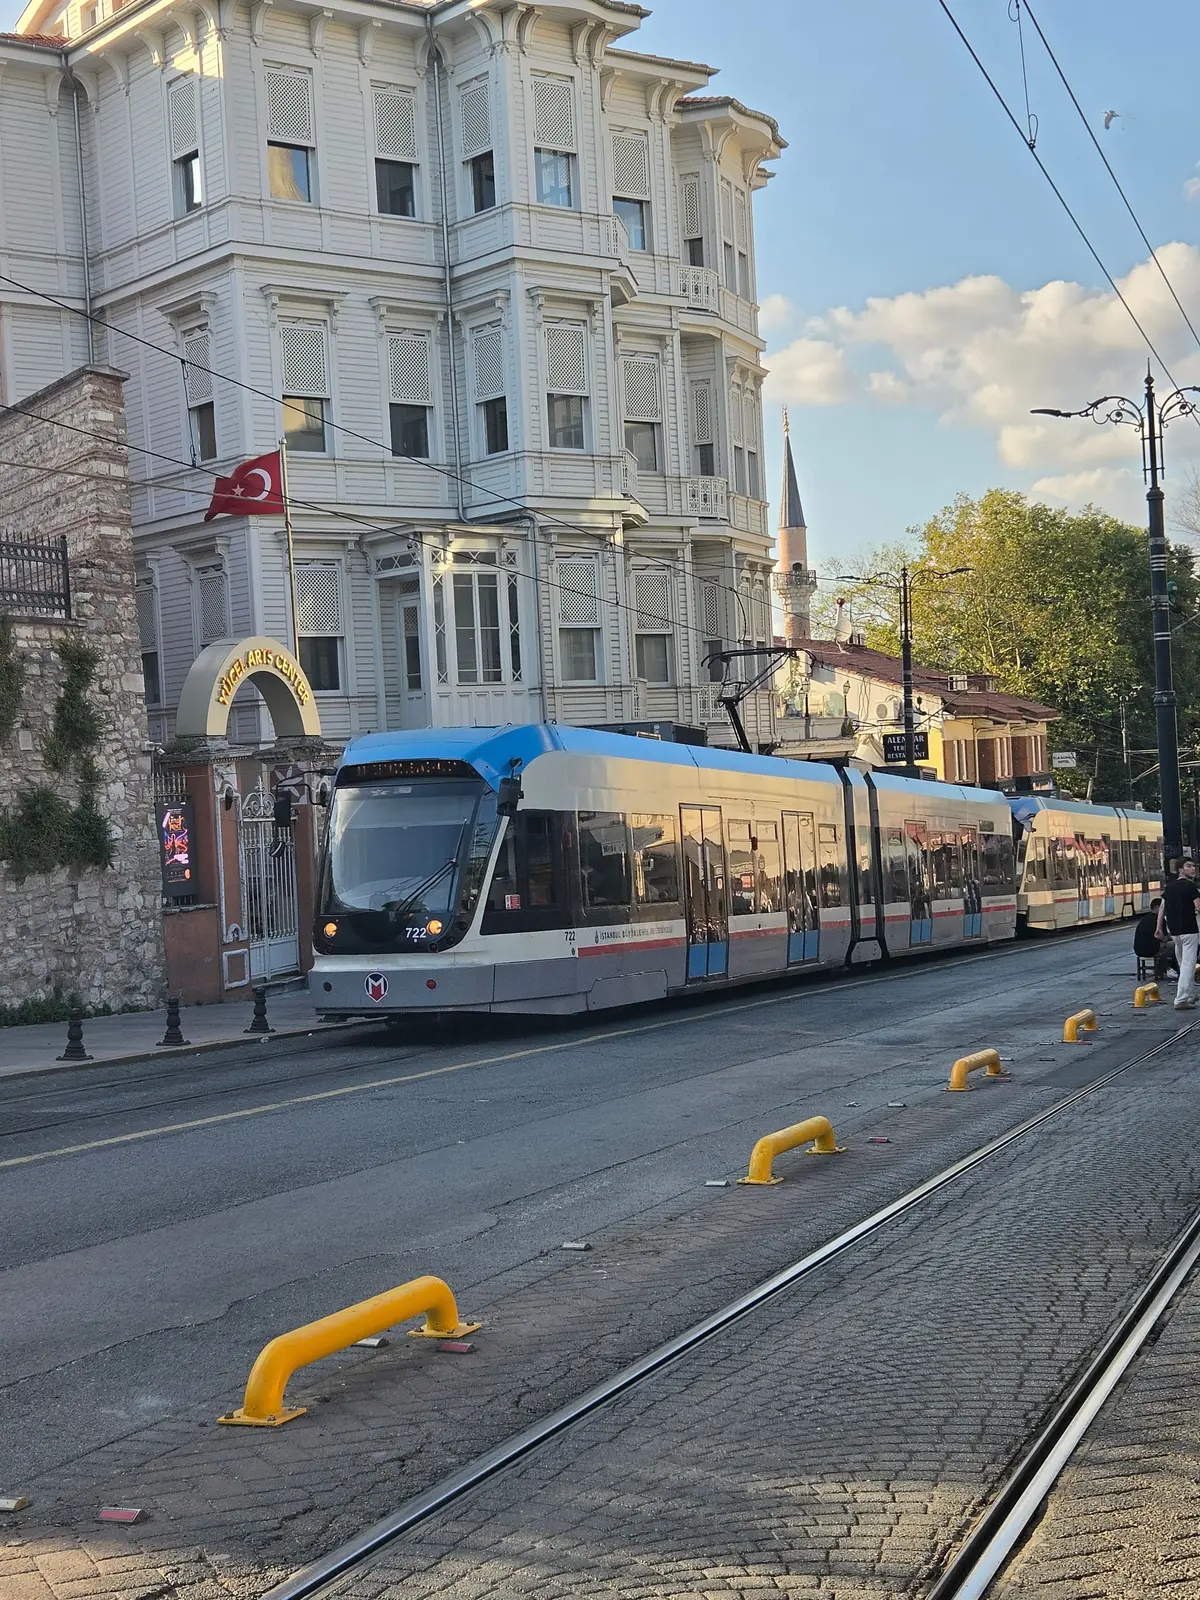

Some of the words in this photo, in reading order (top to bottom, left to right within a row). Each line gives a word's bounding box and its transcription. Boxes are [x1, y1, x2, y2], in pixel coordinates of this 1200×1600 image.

[218, 657, 248, 706] YÜCEL
[247, 647, 273, 667] ARTS
[274, 654, 310, 706] CENTER
[887, 735, 925, 744] ALEAR
[892, 744, 920, 752] TERE
[887, 751, 926, 759] RESTAANT
[405, 927, 427, 939] 722
[564, 930, 576, 941] 722
